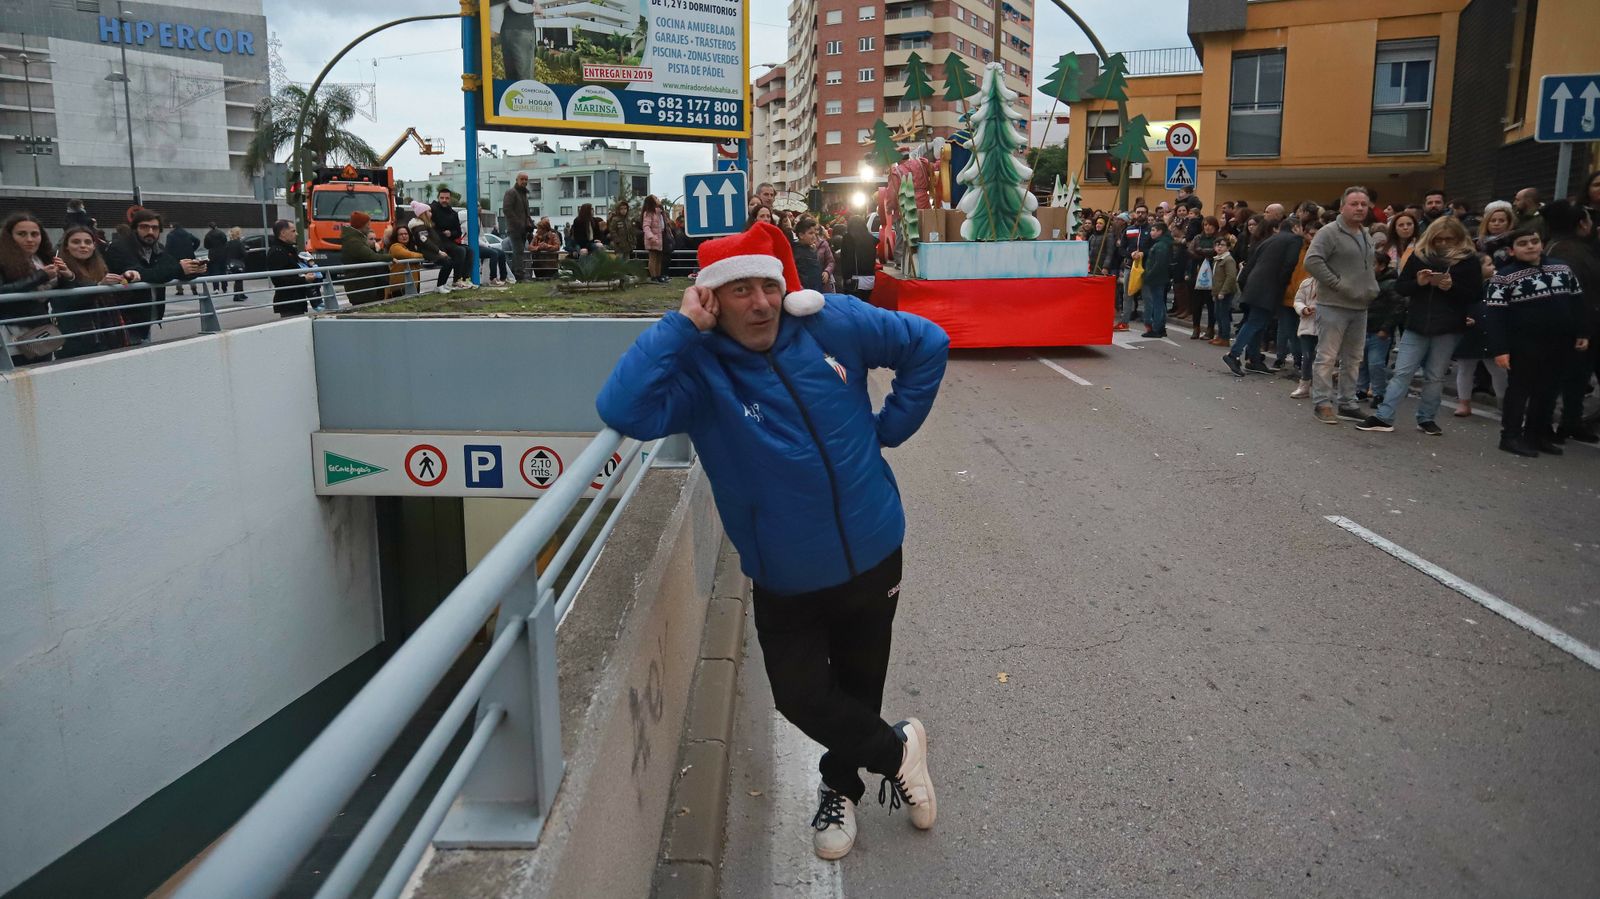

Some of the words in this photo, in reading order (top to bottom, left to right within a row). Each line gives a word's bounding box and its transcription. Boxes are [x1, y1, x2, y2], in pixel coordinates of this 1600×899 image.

[676, 0, 681, 9] Y
[683, 1, 687, 10] 3
[689, 2, 737, 17] DORMITORIOS
[656, 16, 686, 30] COCINA
[687, 21, 735, 37] AMUEBLADA
[655, 31, 689, 45] GARAJES
[695, 36, 737, 51] TRASTEROS
[652, 46, 682, 59] PISCINA
[688, 50, 711, 62] ZONAS
[712, 53, 739, 65] VERDES
[584, 67, 620, 79] ENTREGA
[622, 69, 632, 79] EN
[633, 70, 653, 80] 2019
[668, 62, 690, 75] PISTA
[691, 65, 700, 76] DE
[702, 65, 725, 78] PÁDEL
[662, 82, 738, 95] www.miradordelabahia.es
[528, 99, 553, 107] HOGAR
[574, 103, 617, 114] MARINSA
[658, 96, 683, 110] 682
[687, 98, 711, 111] 177
[714, 101, 737, 114] 800
[658, 110, 683, 123] 952
[687, 112, 710, 125] 541
[714, 114, 737, 127] 800
[1173, 133, 1191, 145] 30
[470, 450, 496, 482] P
[531, 468, 553, 477] mts.
